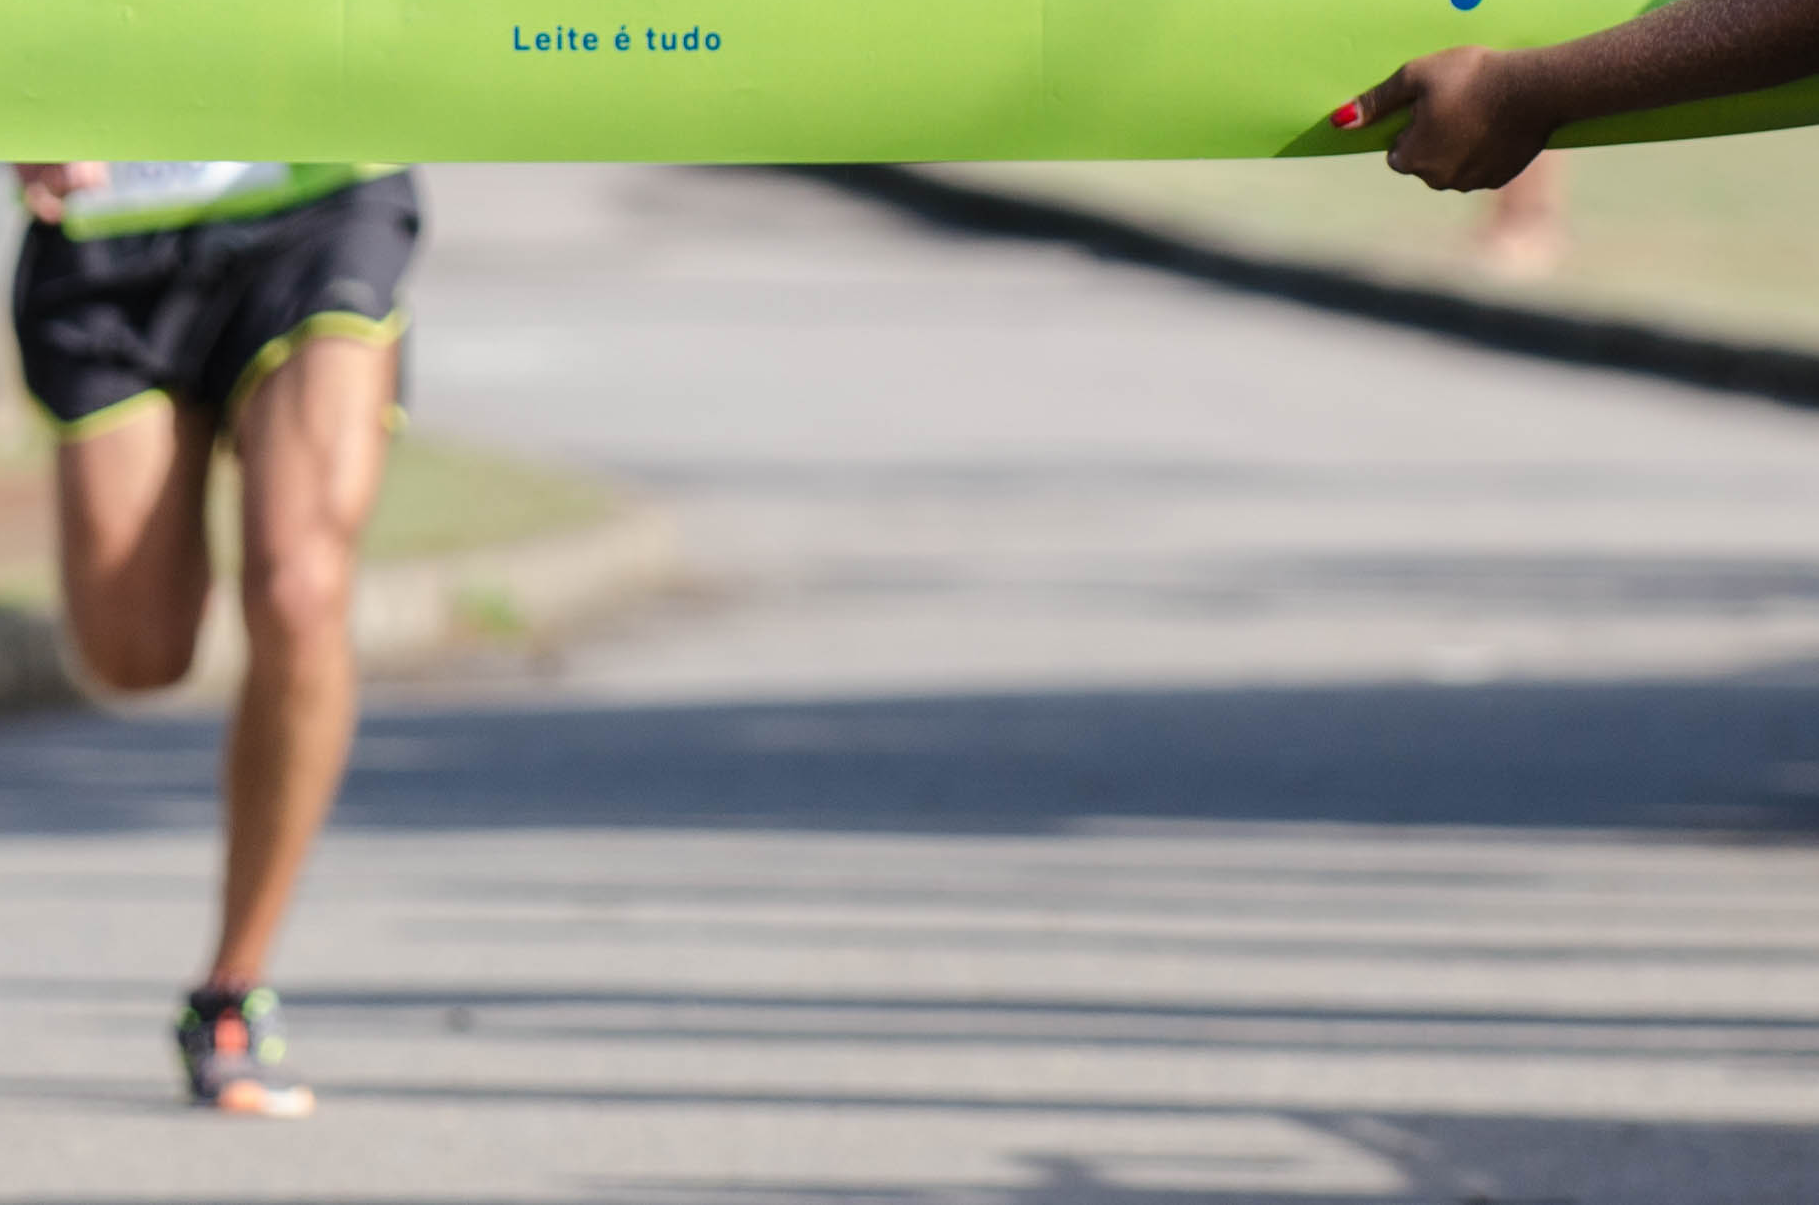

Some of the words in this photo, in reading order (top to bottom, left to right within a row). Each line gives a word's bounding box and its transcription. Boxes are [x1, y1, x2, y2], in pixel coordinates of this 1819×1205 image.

[513, 26, 599, 51] Leite
[614, 26, 631, 51] é
[646, 28, 722, 51] tudo
